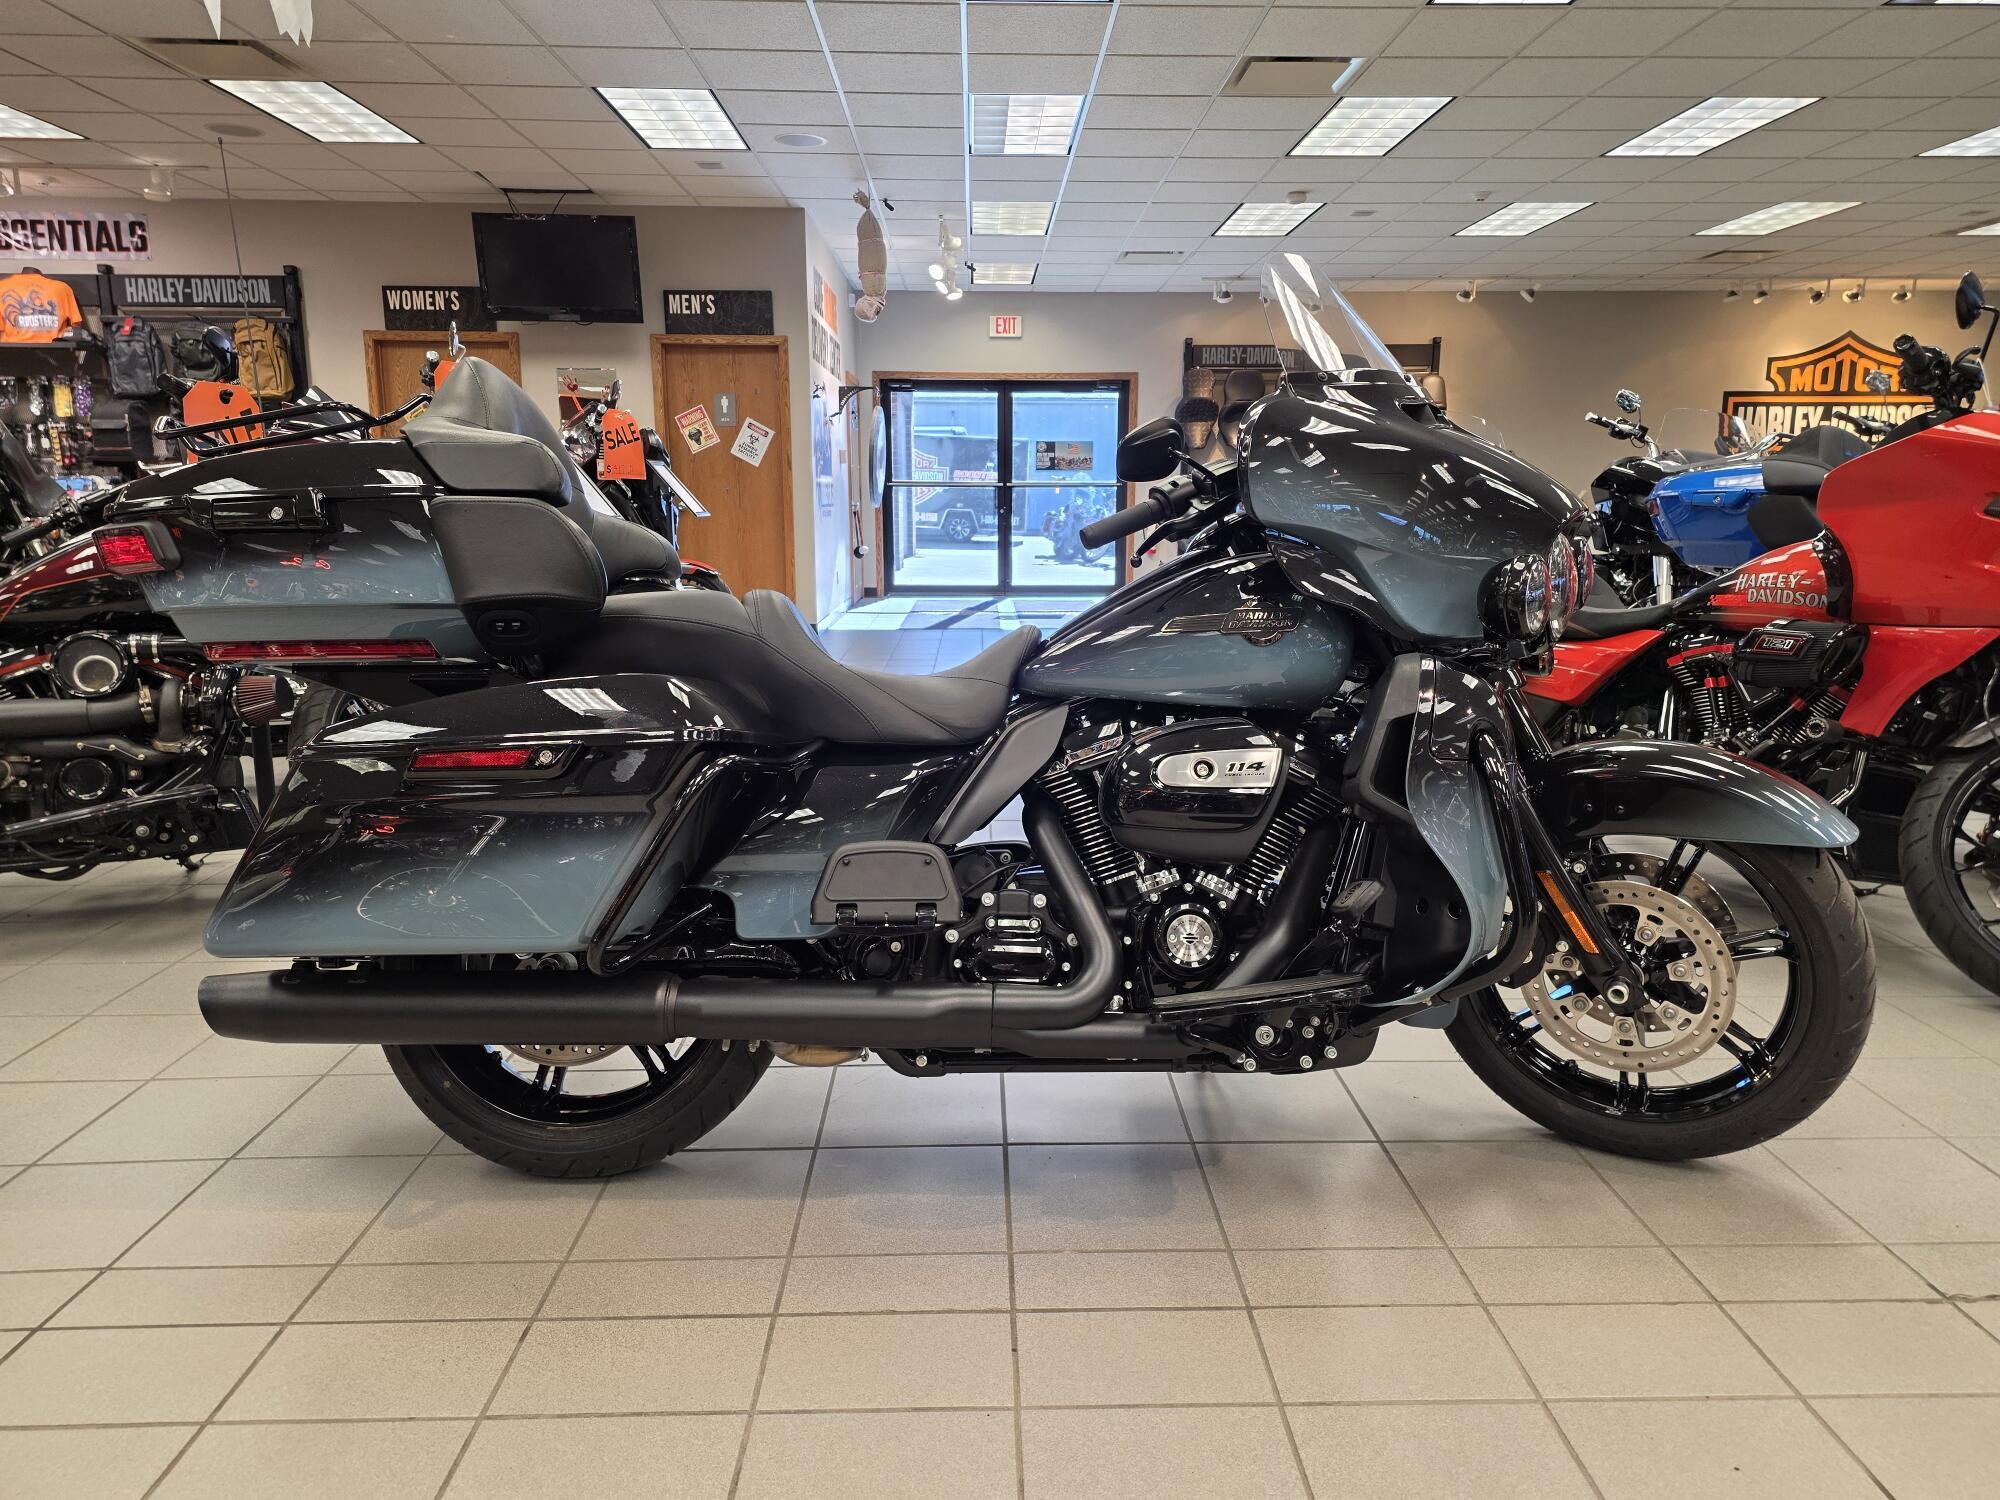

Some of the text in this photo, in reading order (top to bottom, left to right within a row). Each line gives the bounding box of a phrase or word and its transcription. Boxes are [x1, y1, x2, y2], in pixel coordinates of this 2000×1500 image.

[124, 277, 272, 303] HARLEY-DAVIDSON
[386, 290, 460, 311] WOMEN'S
[668, 294, 716, 315] MEN'S
[995, 316, 1017, 335] EXIT
[1737, 404, 1936, 443] HARLEY-DAVIDS
[604, 422, 641, 450] SALE
[1227, 761, 1266, 772] 114
